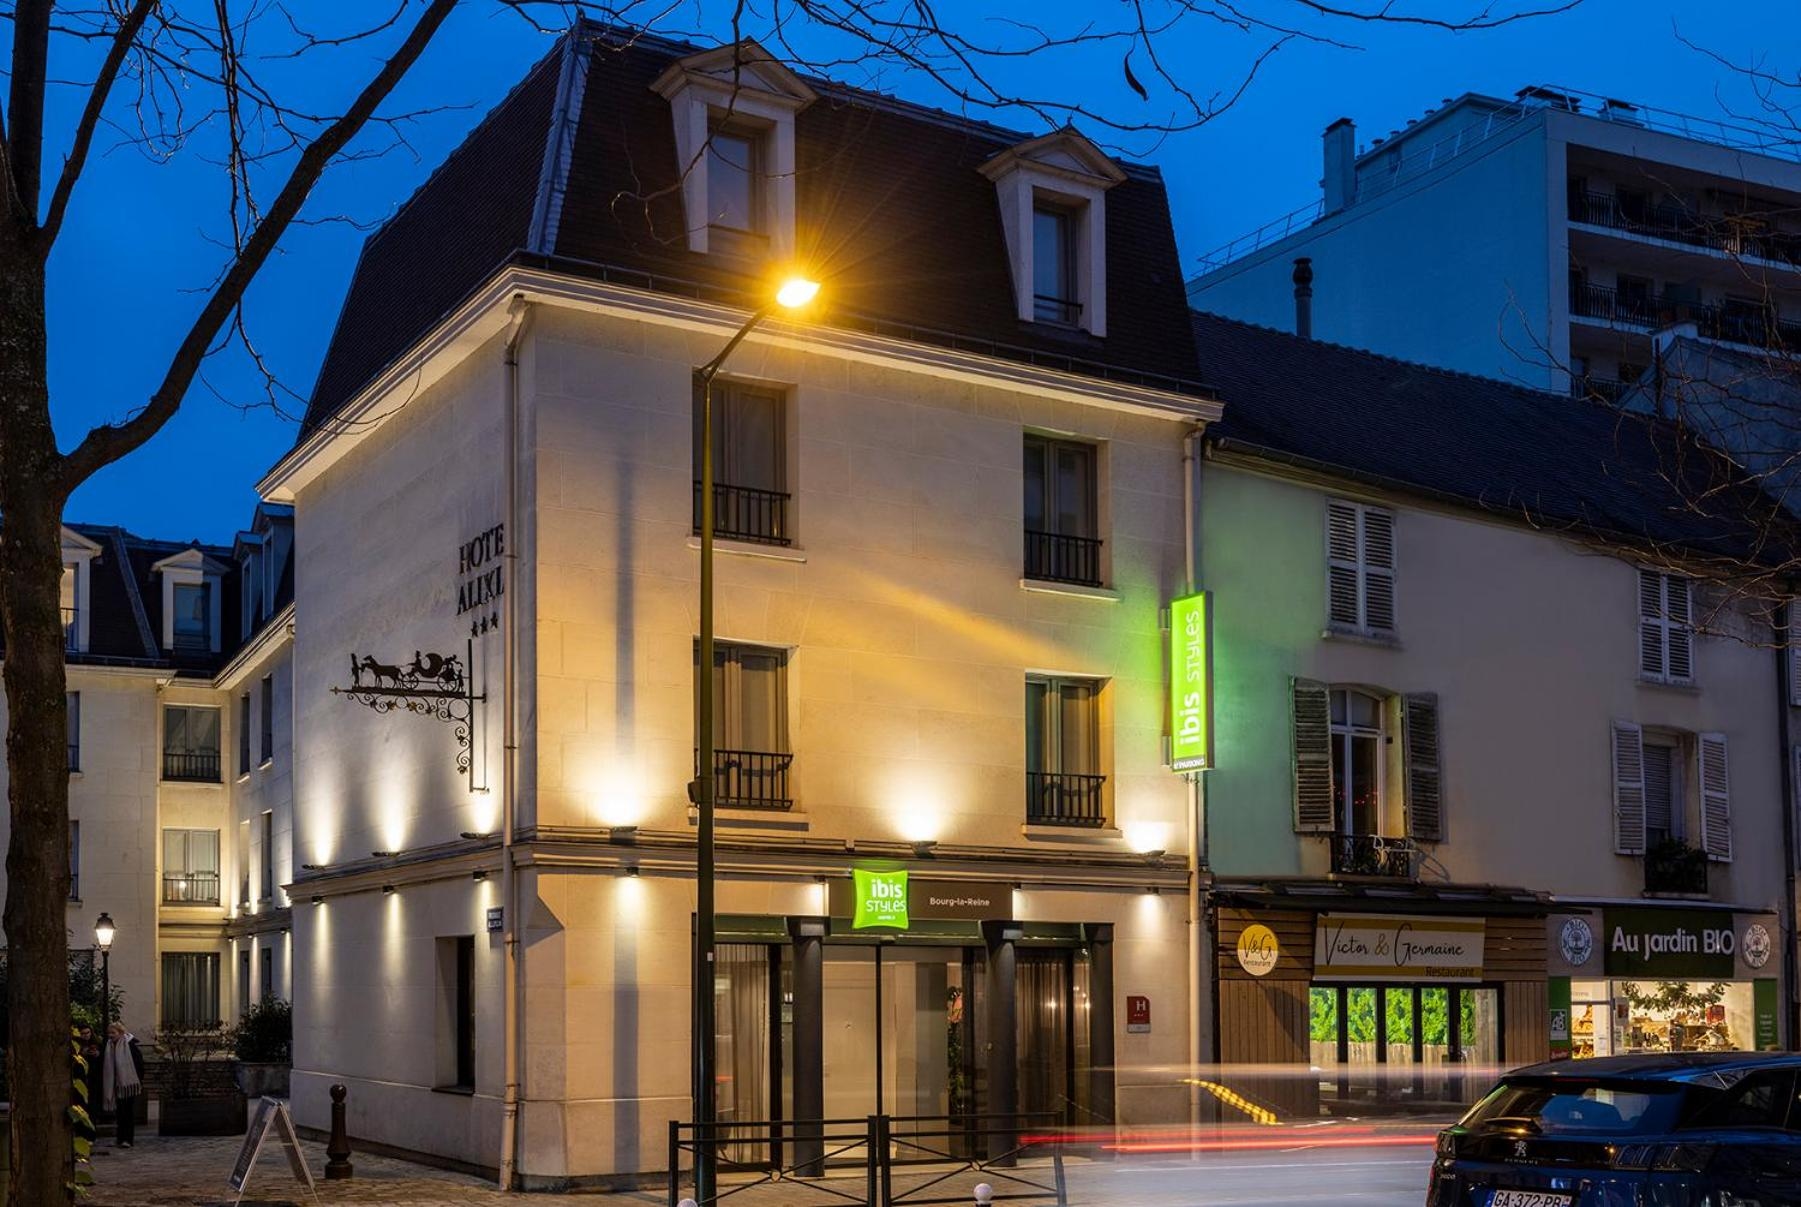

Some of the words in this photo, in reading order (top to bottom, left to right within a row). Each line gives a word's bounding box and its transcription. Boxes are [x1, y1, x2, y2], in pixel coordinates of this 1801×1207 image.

[458, 523, 504, 575] HOTE
[1179, 691, 1200, 745] ibis
[871, 878, 903, 899] ibis
[930, 896, 990, 907] Bourg-la-Reine
[866, 899, 906, 913] STYLES
[1242, 933, 1272, 960] V&G
[1324, 921, 1369, 967] Victor
[1375, 932, 1390, 956] &
[1395, 921, 1466, 967] Germaine
[1611, 926, 1639, 952] Au
[1644, 927, 1698, 961] jardin
[1703, 929, 1735, 955] BIO
[1424, 966, 1475, 978] Restaurant
